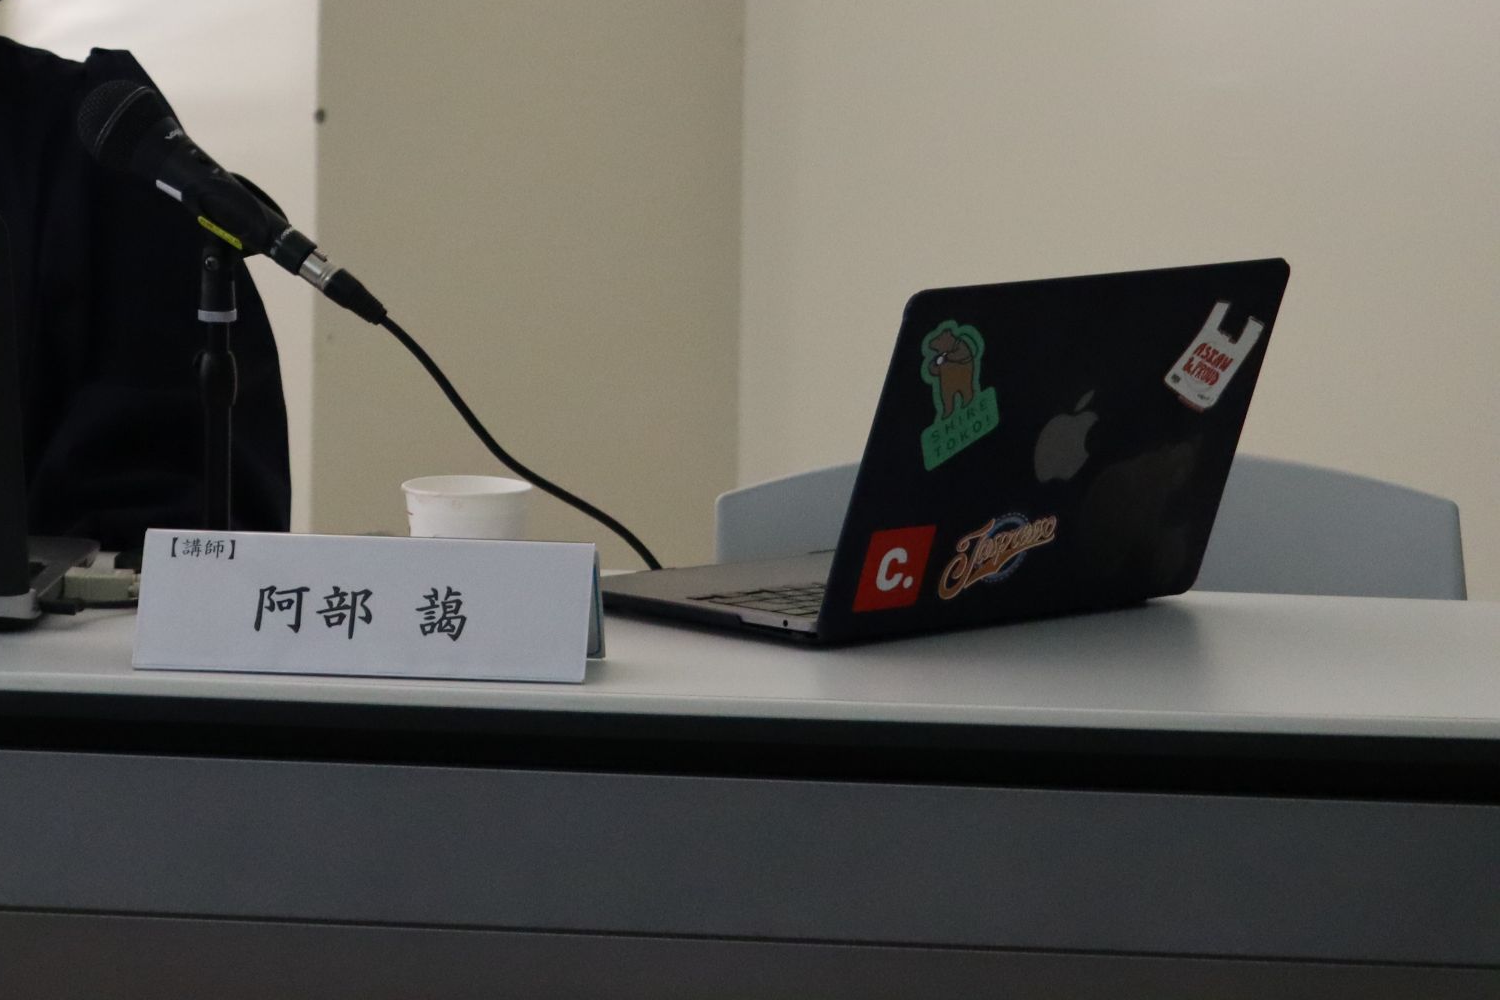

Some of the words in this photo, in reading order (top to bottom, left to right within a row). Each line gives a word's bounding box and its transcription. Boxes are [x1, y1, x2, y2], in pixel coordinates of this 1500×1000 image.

[931, 397, 989, 443] SHIRE
[933, 414, 991, 457] TOKO!
[170, 536, 237, 561] 【講師】
[876, 546, 914, 592] C.
[254, 585, 374, 640] 阿部
